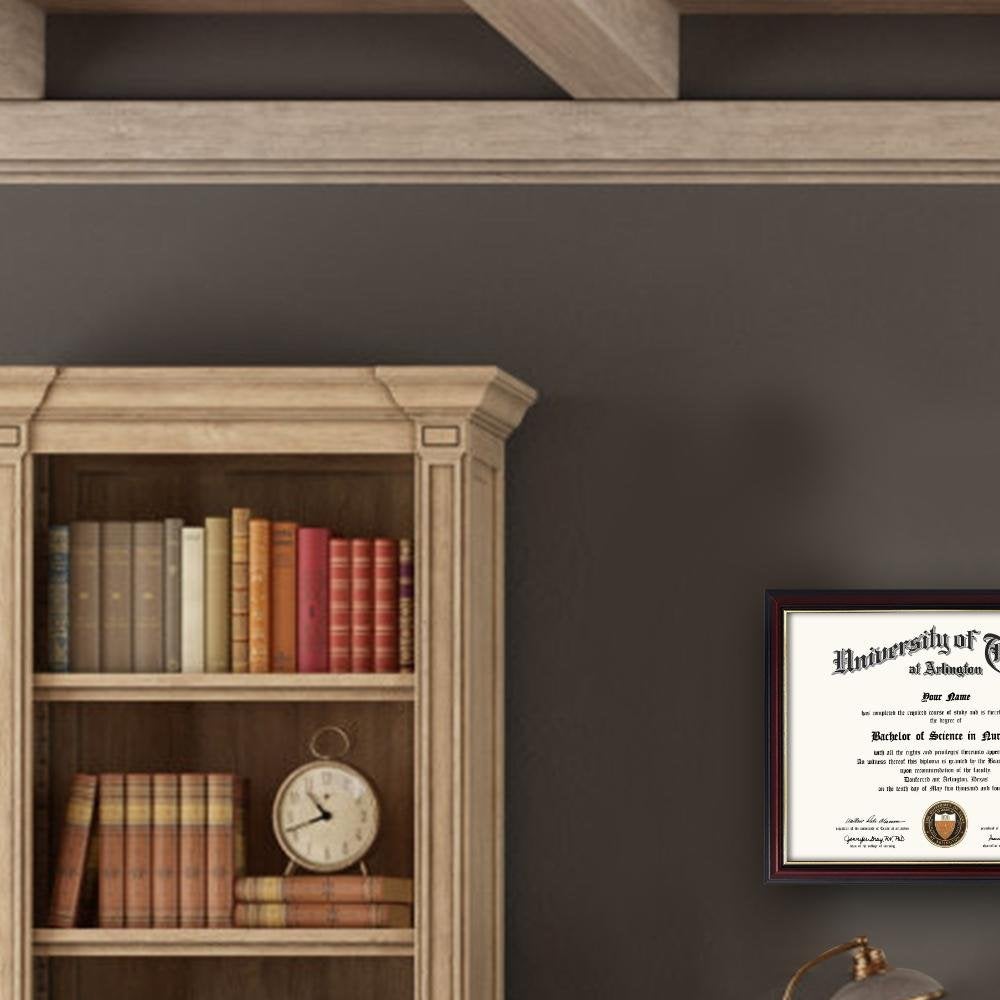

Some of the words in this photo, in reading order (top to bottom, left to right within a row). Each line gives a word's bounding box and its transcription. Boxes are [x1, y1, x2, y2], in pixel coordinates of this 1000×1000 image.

[832, 625, 950, 675] University
[953, 629, 981, 650] of
[909, 662, 921, 675] at
[923, 660, 983, 677] Arlington
[921, 692, 943, 703] Your
[945, 692, 971, 702] Name
[871, 731, 911, 743] Bachelor
[915, 731, 925, 741] of
[928, 730, 963, 741] Science
[967, 730, 976, 741] in
